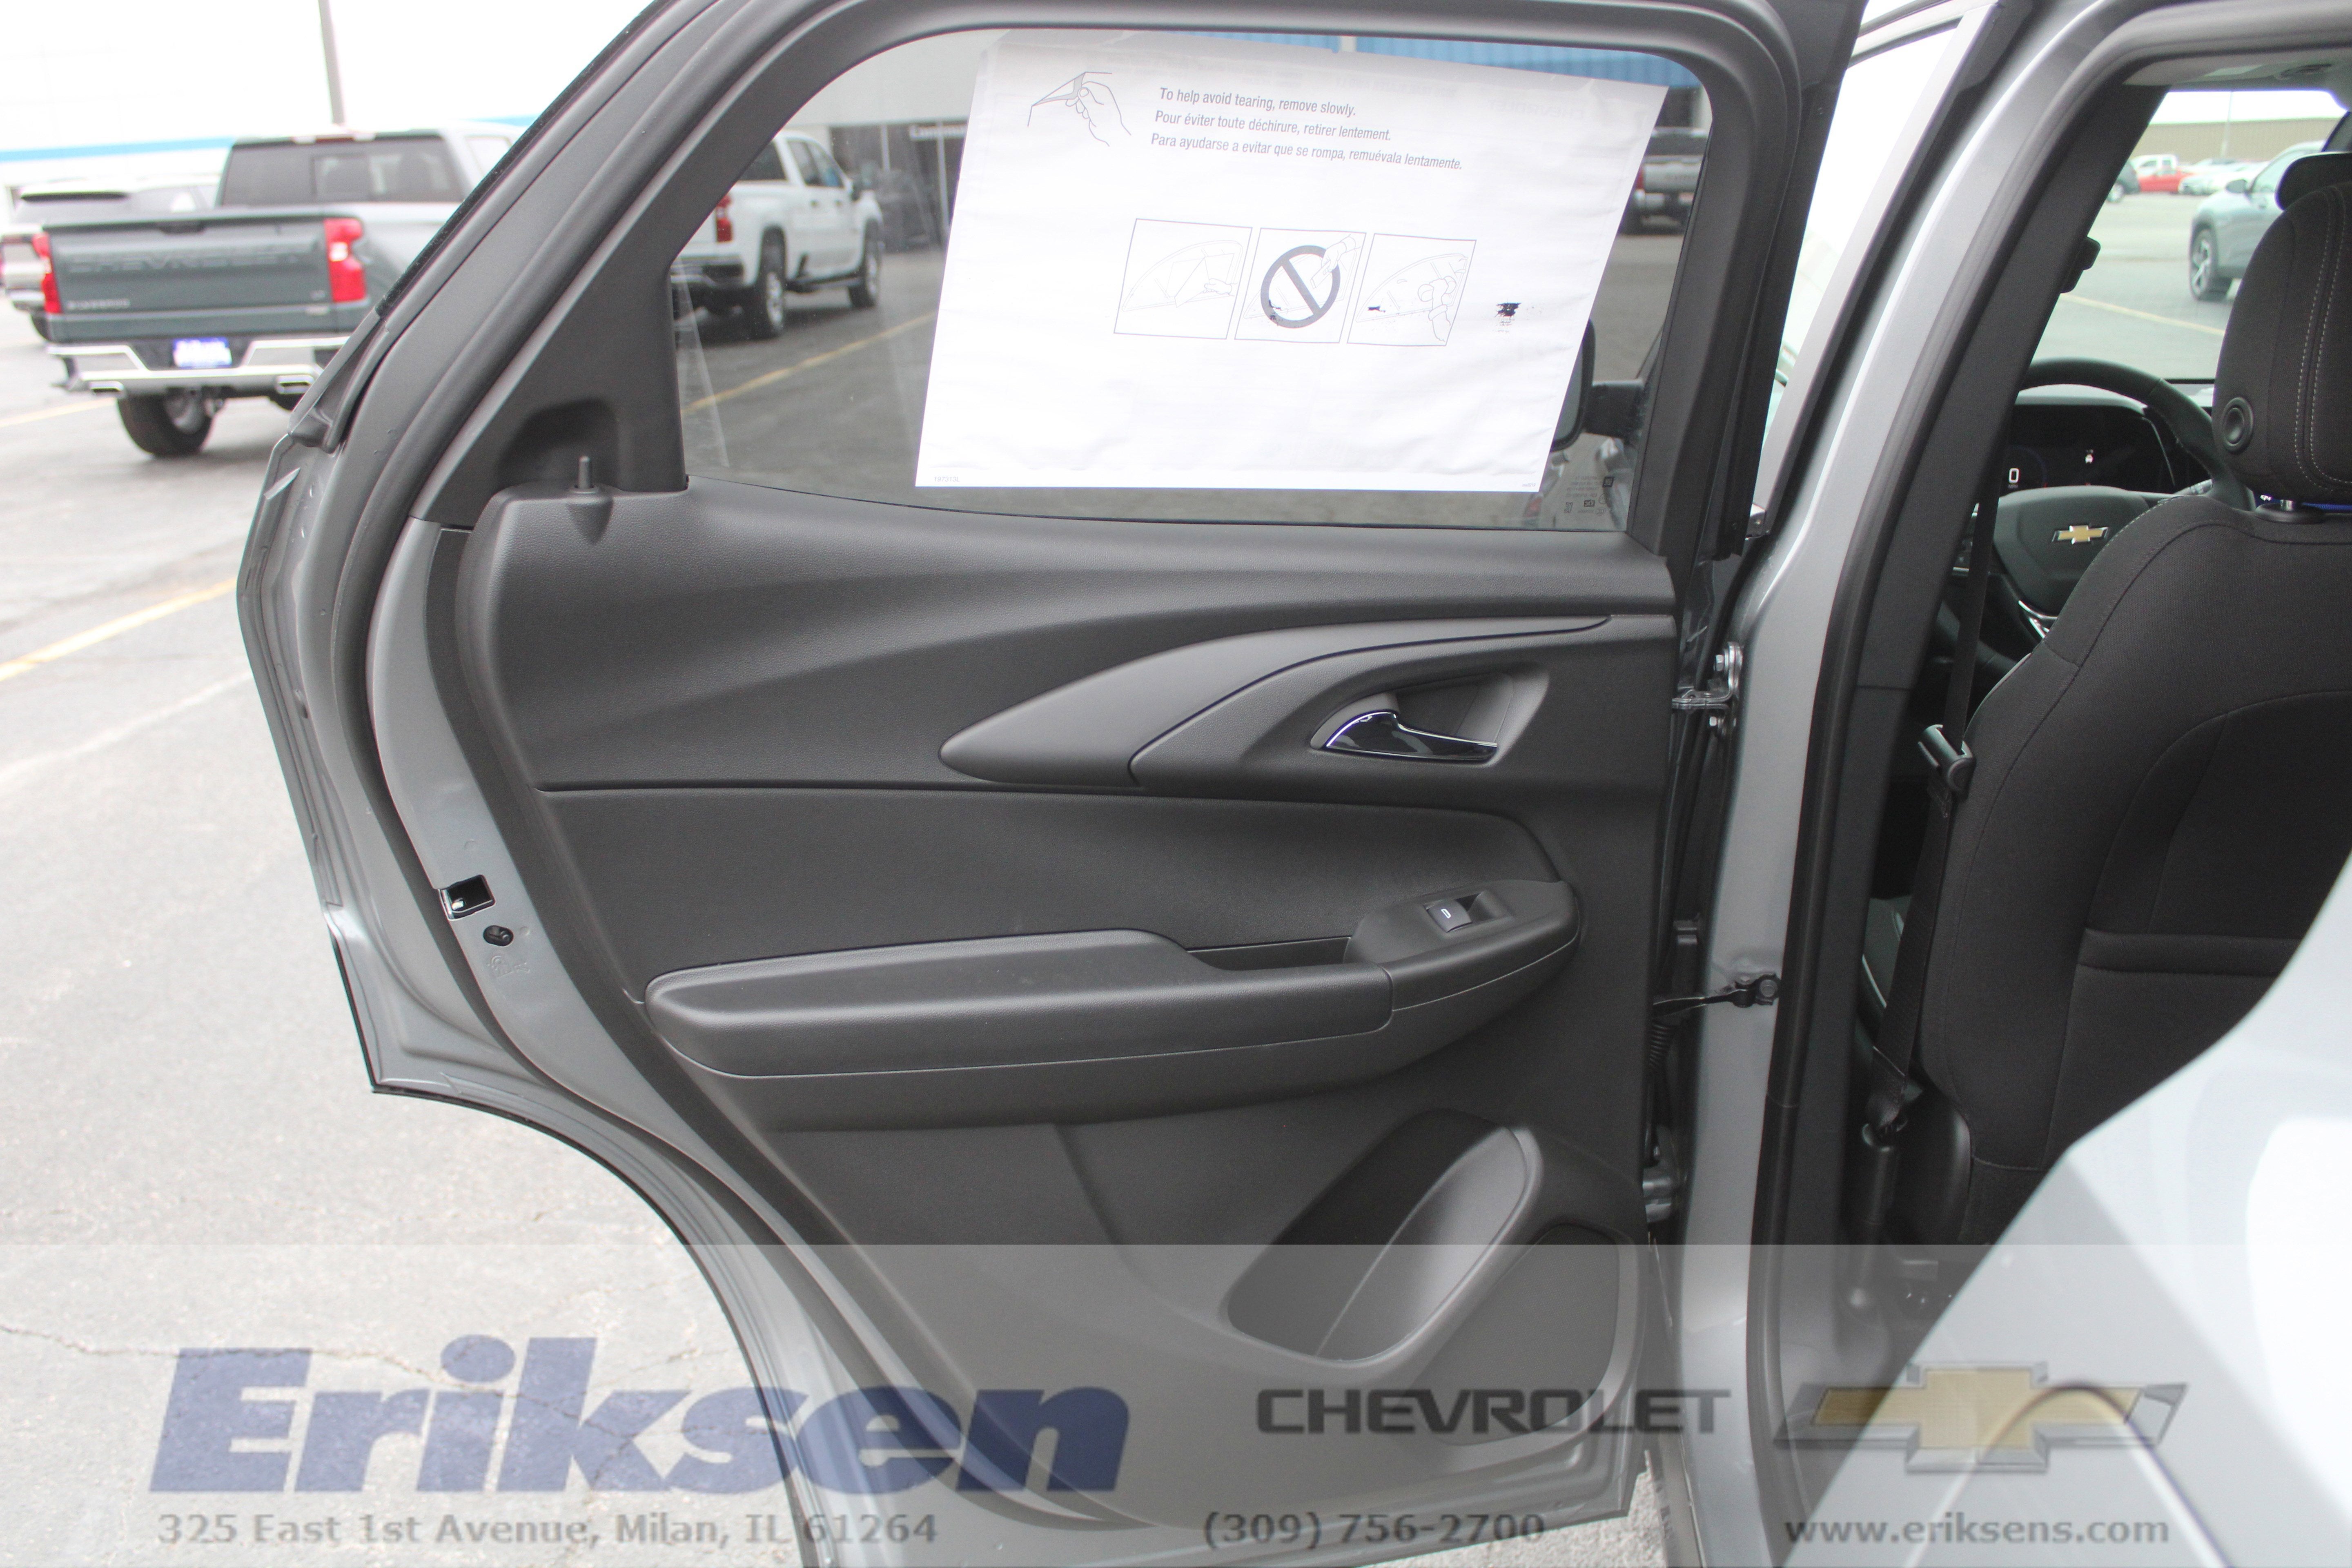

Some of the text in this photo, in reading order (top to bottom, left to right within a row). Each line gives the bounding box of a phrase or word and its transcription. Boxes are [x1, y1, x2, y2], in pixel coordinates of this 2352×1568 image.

[1160, 87, 1356, 118] To help avoid tearing, remove slowly.
[1155, 110, 1391, 141] Pour éviter toute déchirure, retirer lentement.
[1151, 133, 1462, 170] Para ayudarse a evitar que se rompa, remuévala lentamente.
[2009, 468, 2019, 483] 0
